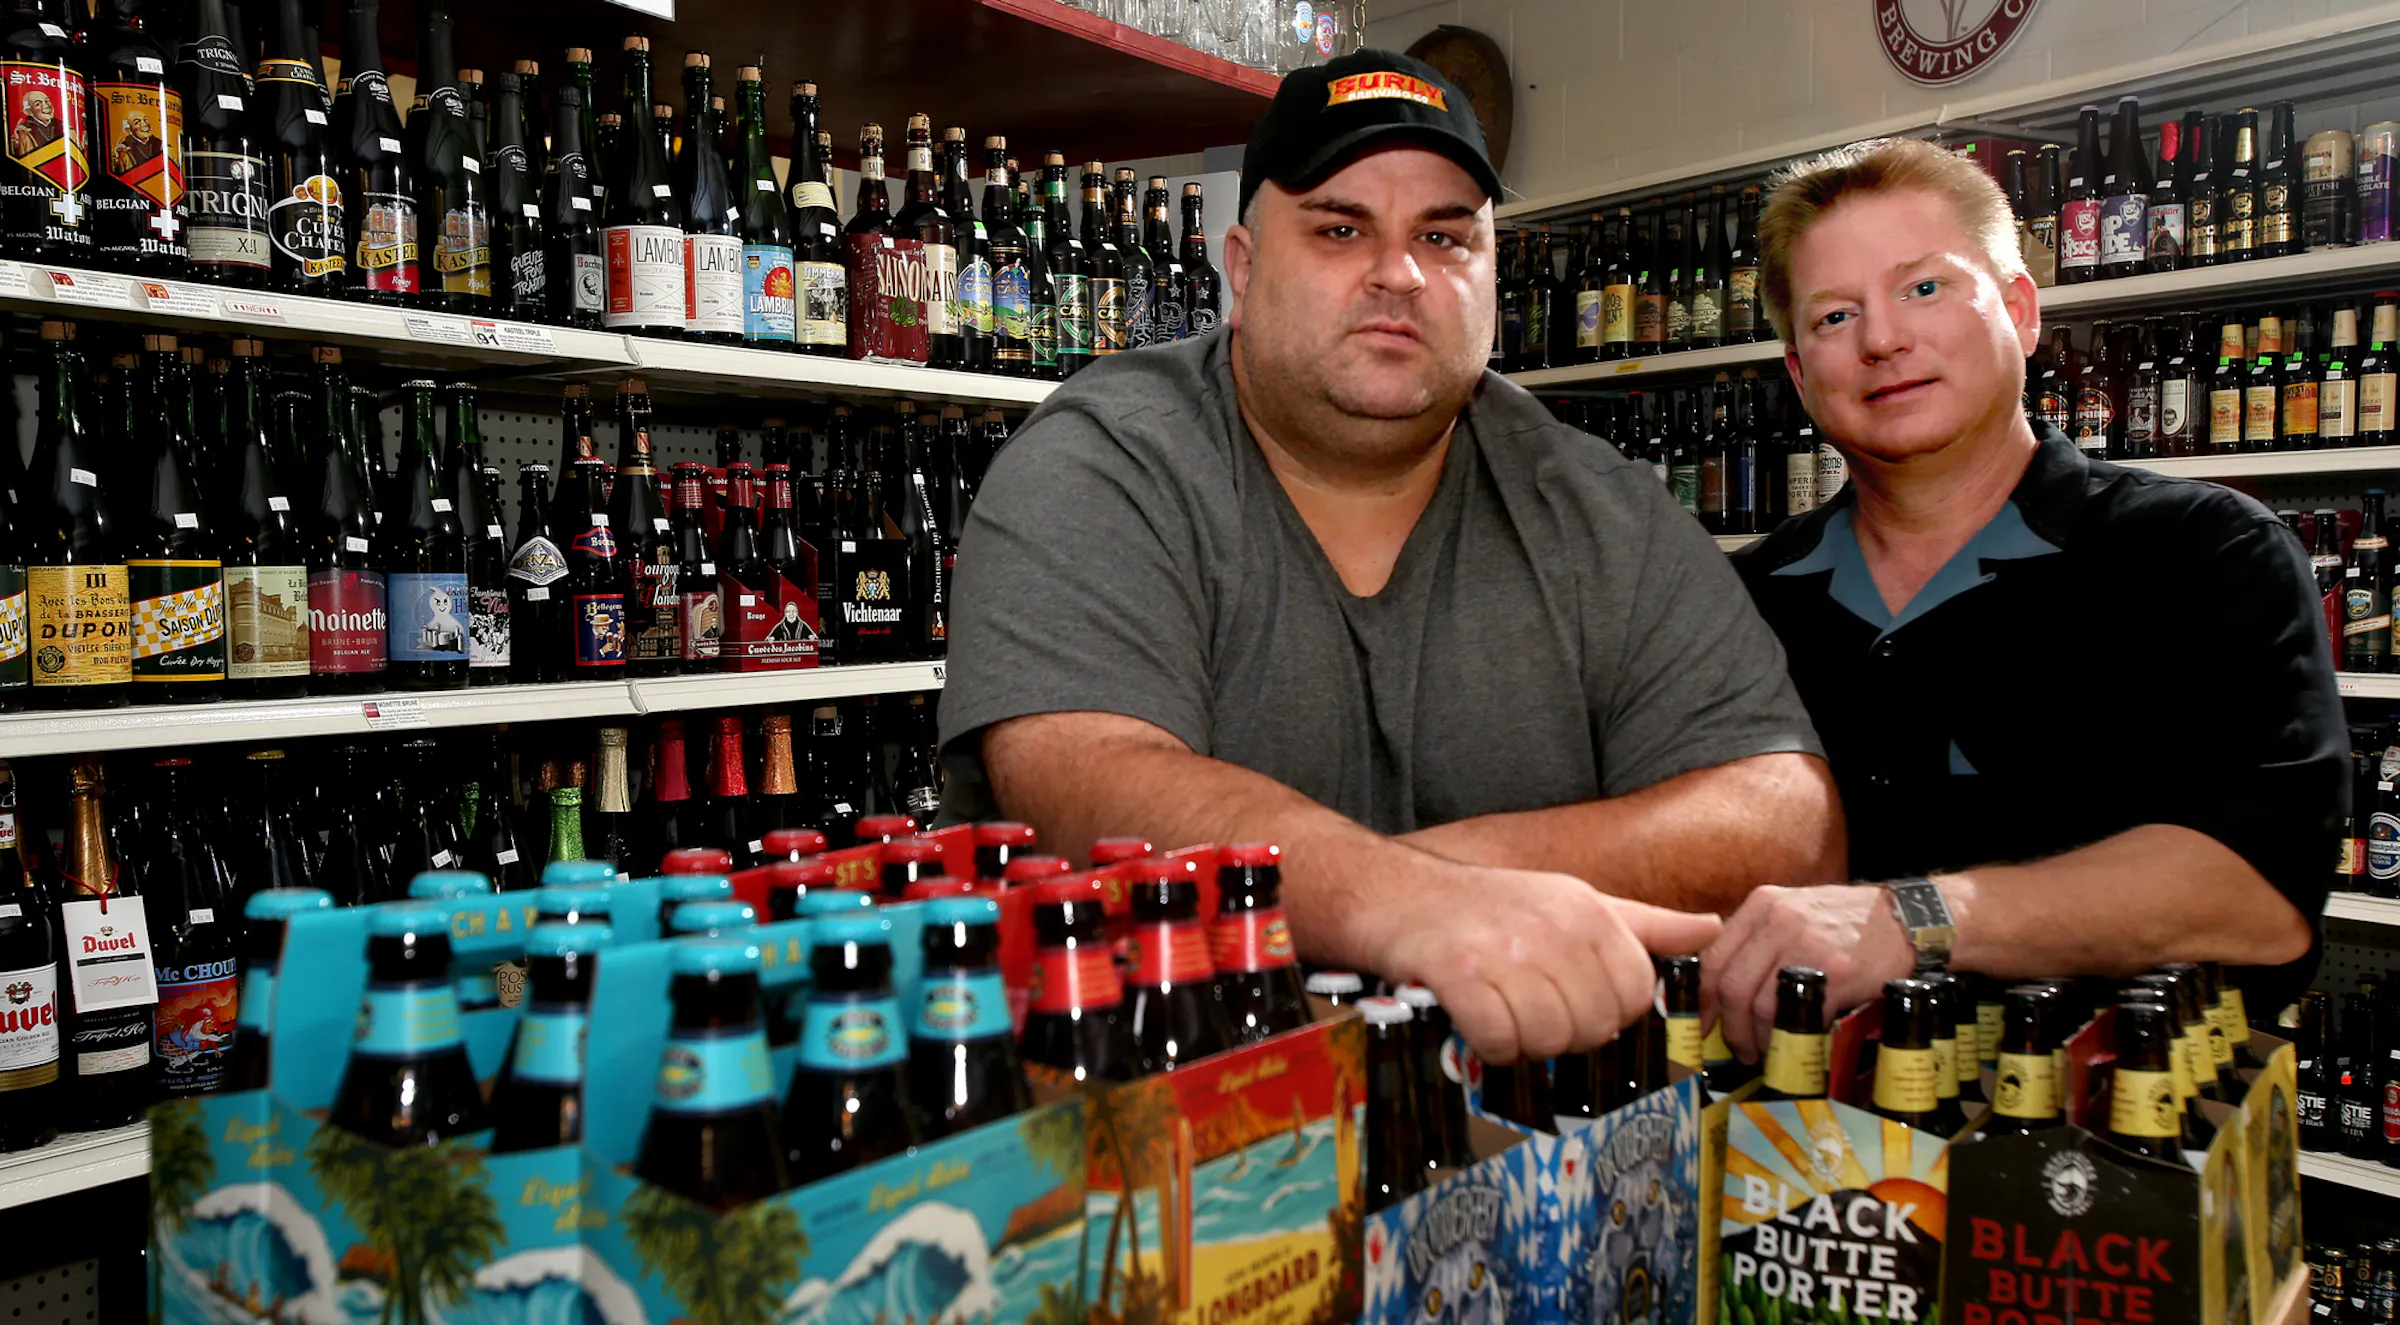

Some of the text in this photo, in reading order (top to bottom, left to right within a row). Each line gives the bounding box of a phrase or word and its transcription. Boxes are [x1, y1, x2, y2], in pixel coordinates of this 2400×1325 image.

[1881, 3, 1997, 74] BREWING
[1334, 74, 1441, 99] SURLY
[1348, 88, 1411, 101] BREWING
[0, 186, 55, 197] BELGIAN
[96, 198, 150, 210] BELGIAN
[246, 305, 266, 313] NEW
[477, 333, 499, 345] 91
[308, 608, 387, 632] Moinette
[842, 601, 903, 624] Vichtenaar
[159, 614, 204, 637] SAISON
[190, 656, 205, 667] Dry
[82, 932, 136, 953] Duvel
[155, 968, 180, 982] Mc
[1743, 1173, 1919, 1244] BLACK
[1754, 1223, 1899, 1281] BUTTE
[1970, 1216, 2174, 1284] BLACK
[1734, 1251, 1919, 1322] PORTER
[1988, 1268, 2155, 1322] BUTTE
